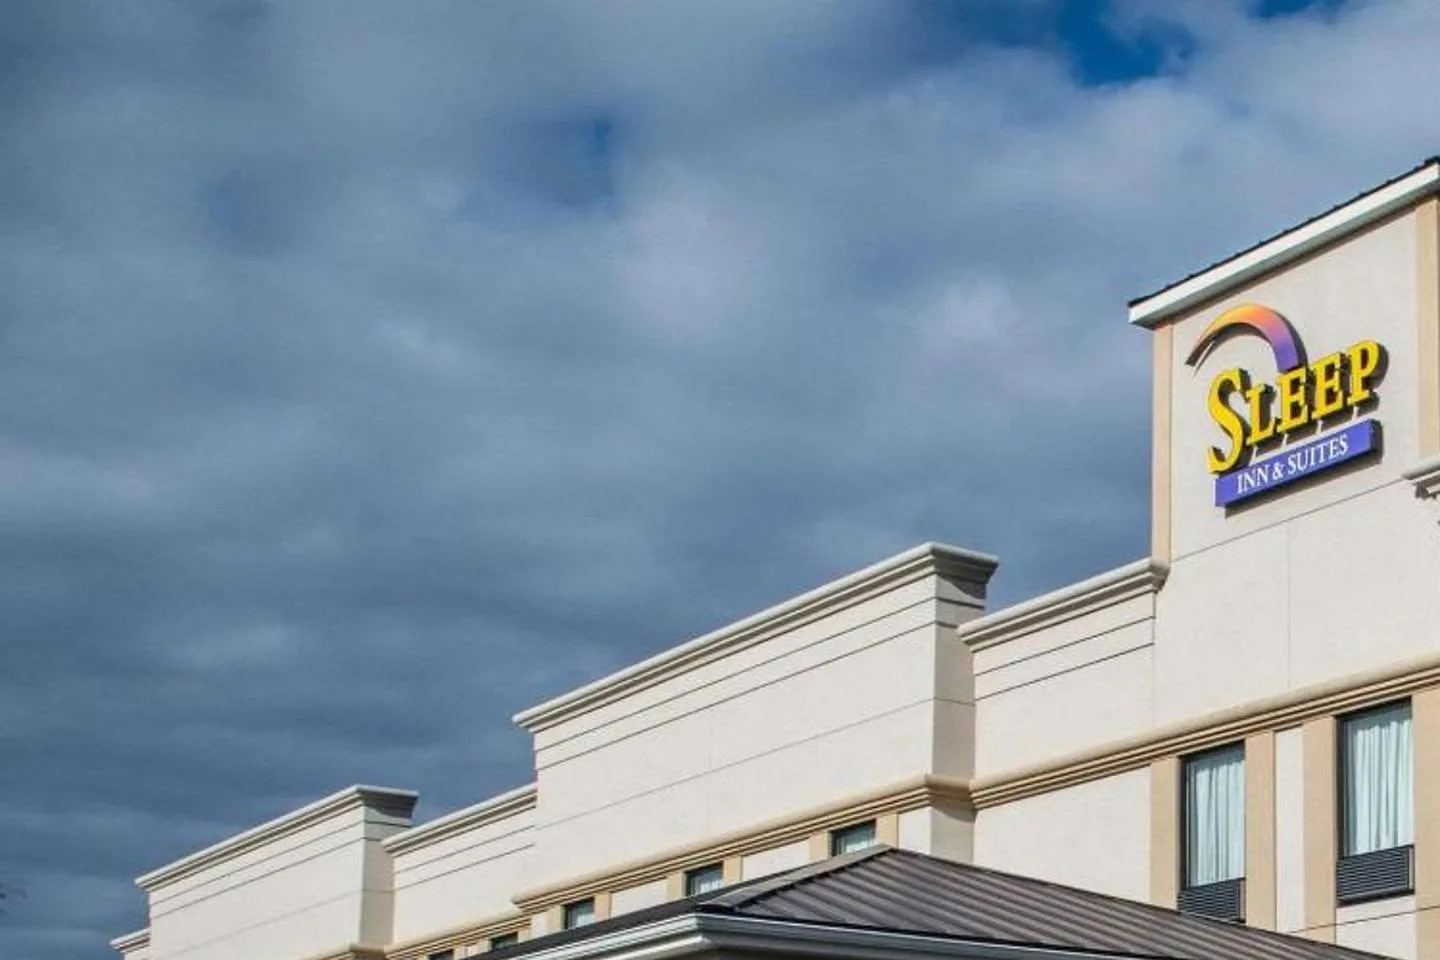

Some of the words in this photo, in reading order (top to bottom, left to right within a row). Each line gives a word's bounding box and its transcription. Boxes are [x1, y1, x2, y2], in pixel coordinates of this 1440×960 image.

[1207, 339, 1380, 475] SLEEP
[1236, 464, 1270, 494] INN
[1272, 461, 1285, 481] &
[1287, 433, 1349, 475] SUITES
